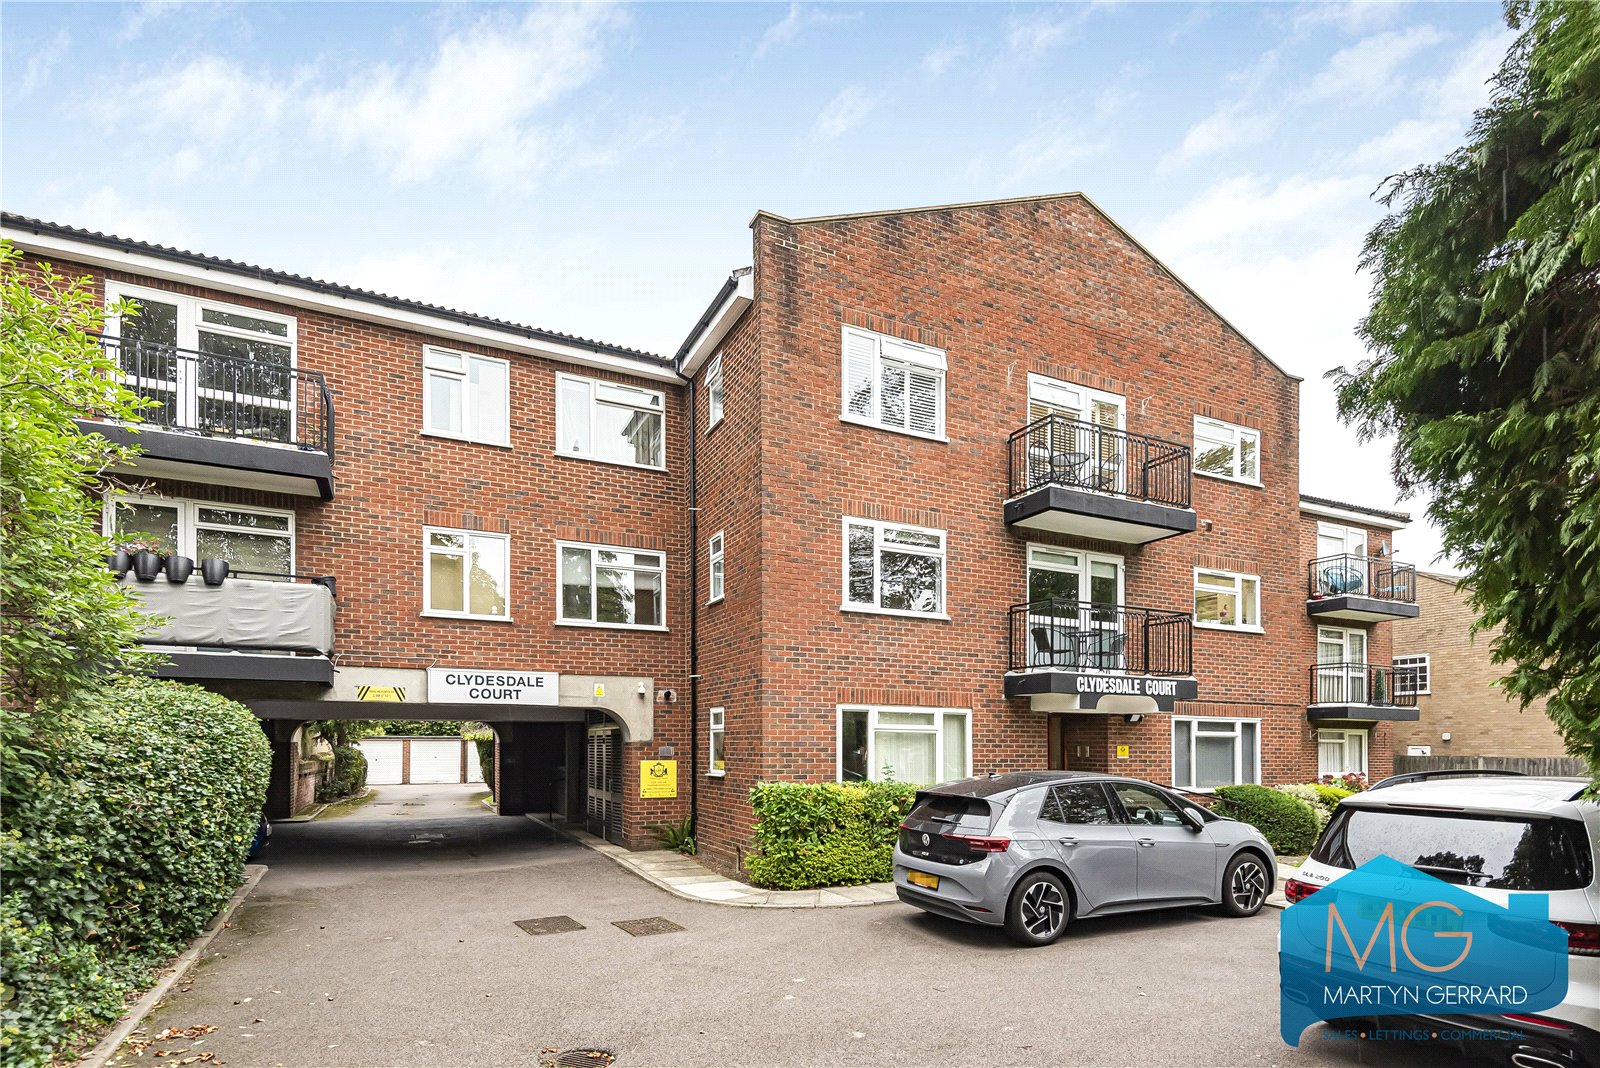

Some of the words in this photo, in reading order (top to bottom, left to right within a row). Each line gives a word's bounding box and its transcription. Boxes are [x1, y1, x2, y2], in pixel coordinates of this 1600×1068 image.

[445, 673, 544, 688] CLYDESDALE
[1076, 676, 1141, 695] CLYDESDALE
[1145, 680, 1177, 696] COURT
[469, 687, 522, 700] COURT
